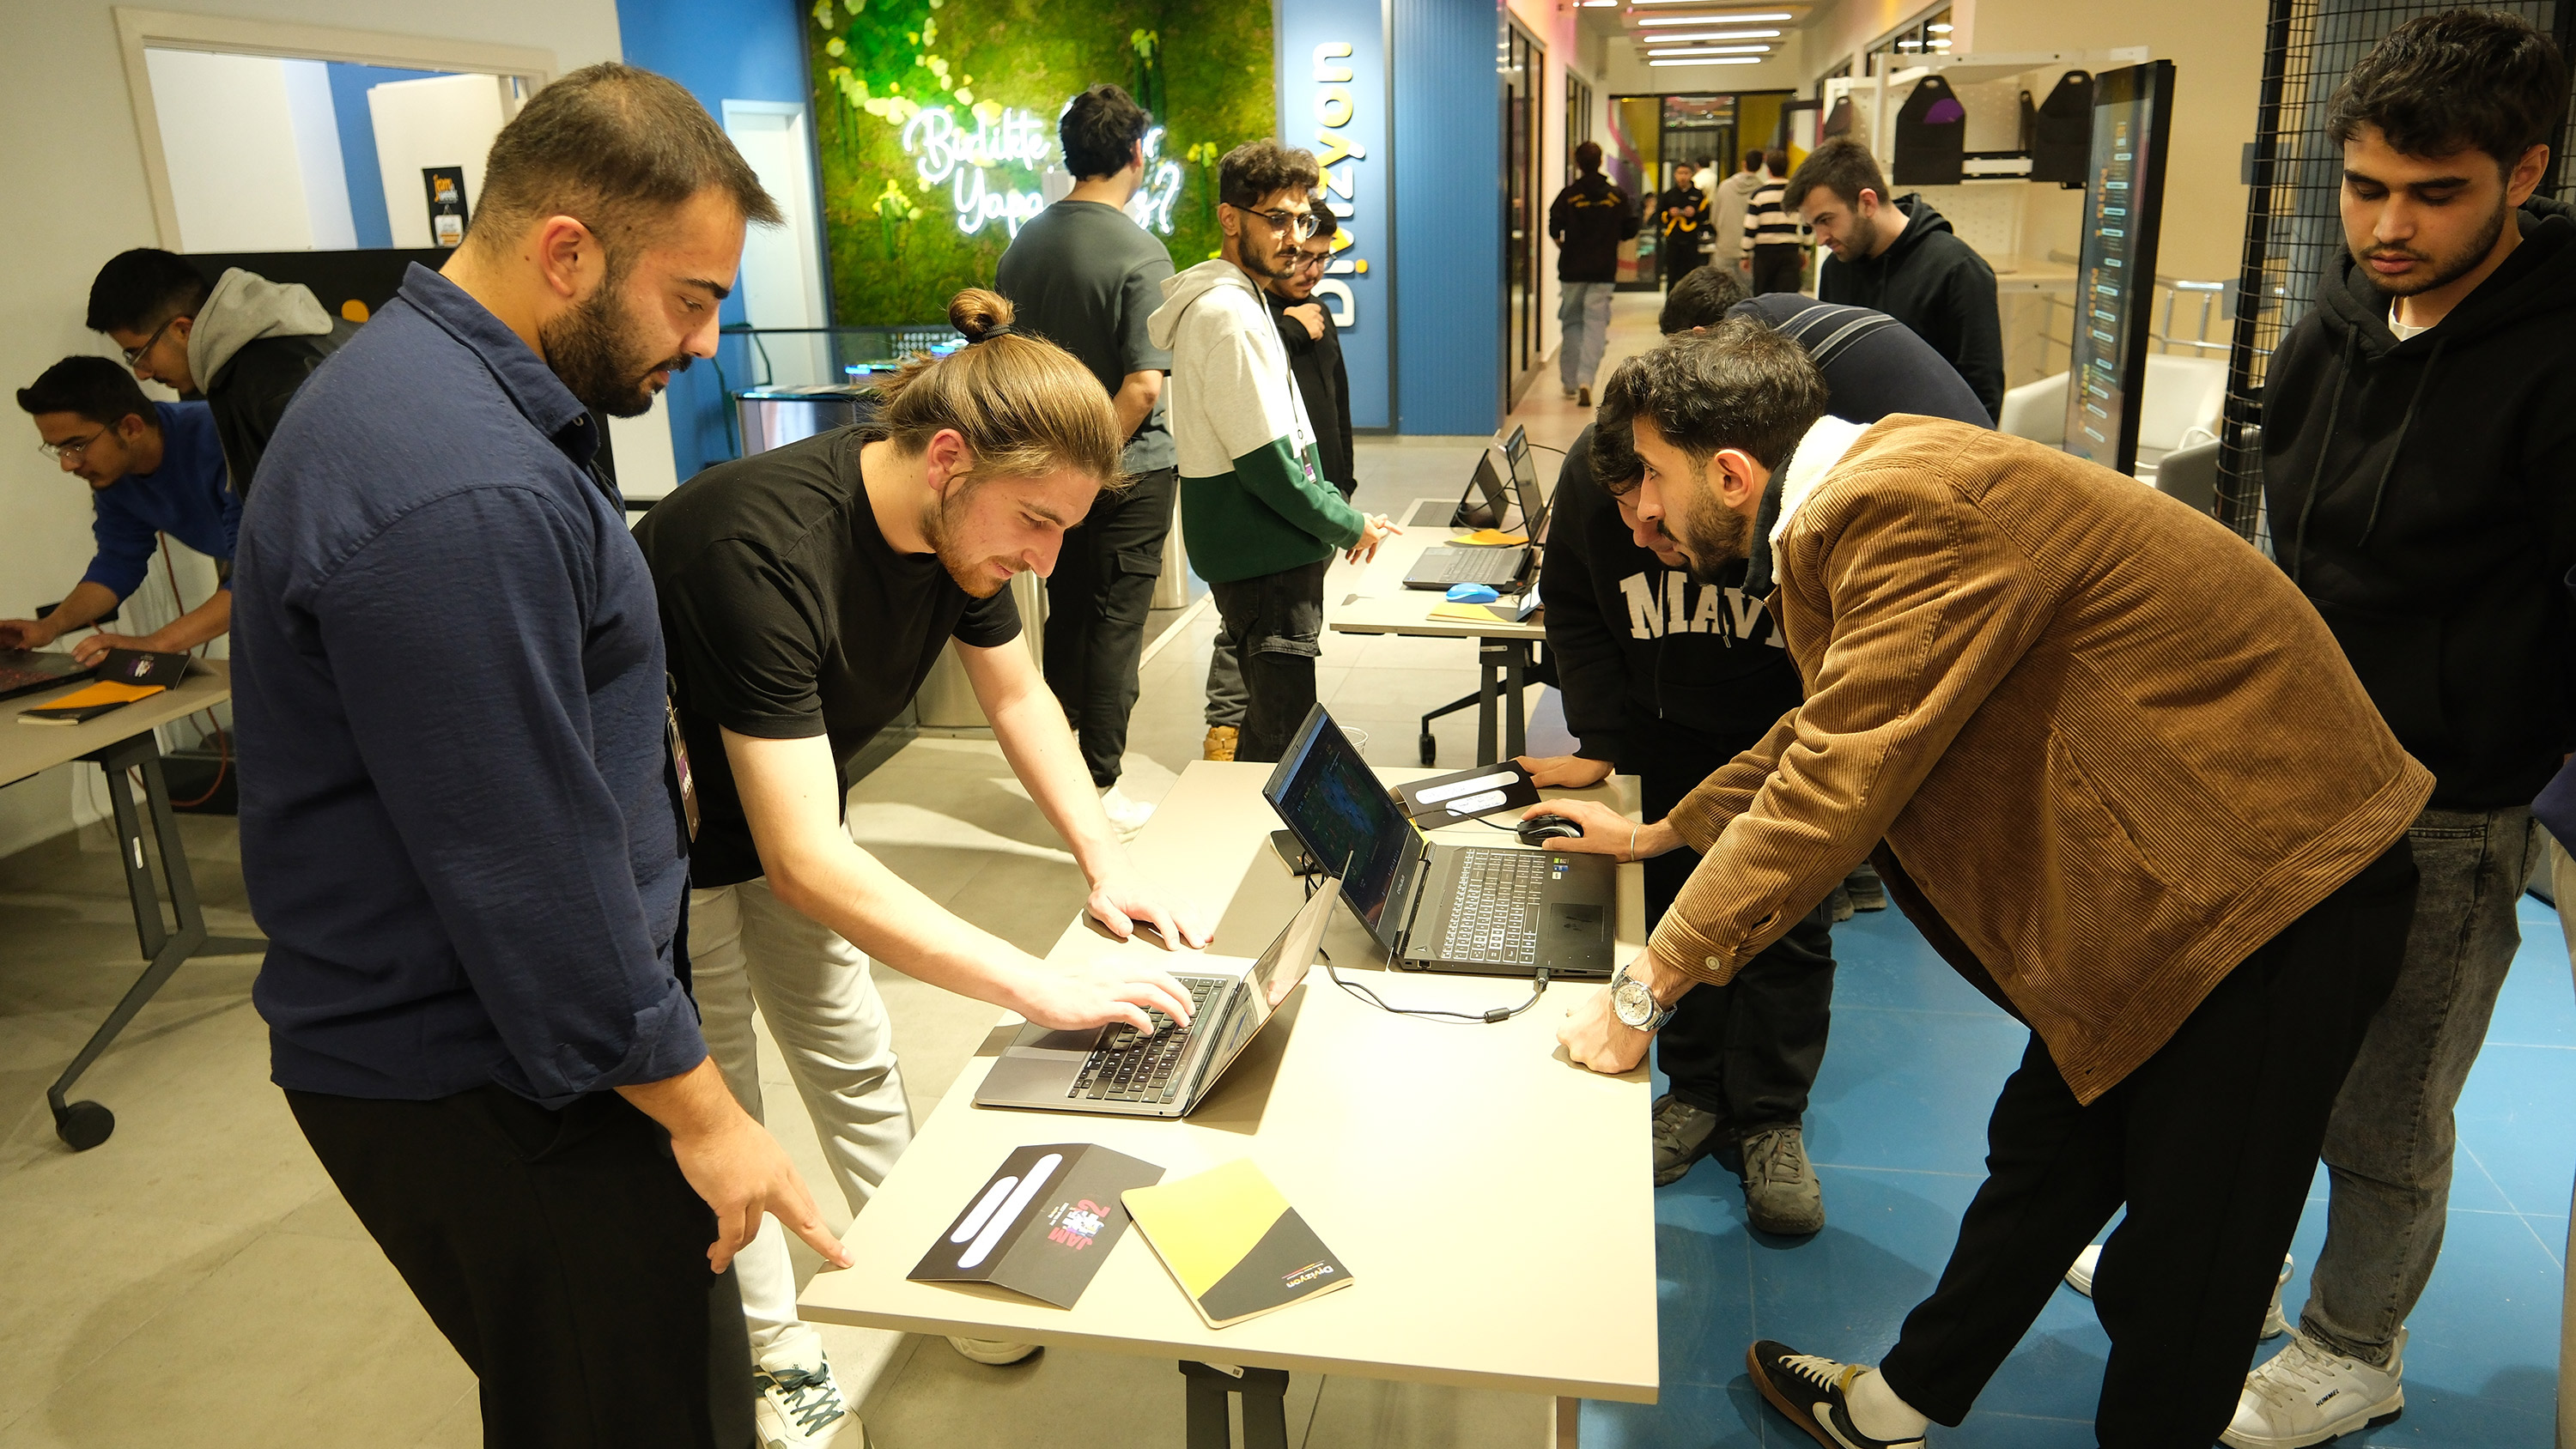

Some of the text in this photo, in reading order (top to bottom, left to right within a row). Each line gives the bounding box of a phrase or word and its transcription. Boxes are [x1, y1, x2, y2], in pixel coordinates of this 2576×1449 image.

[1619, 570, 1785, 649] MAV
[1048, 1226, 1093, 1251] JAM
[1286, 1264, 1334, 1288] Divizyon
[2315, 1388, 2340, 1408] HUMMEL
